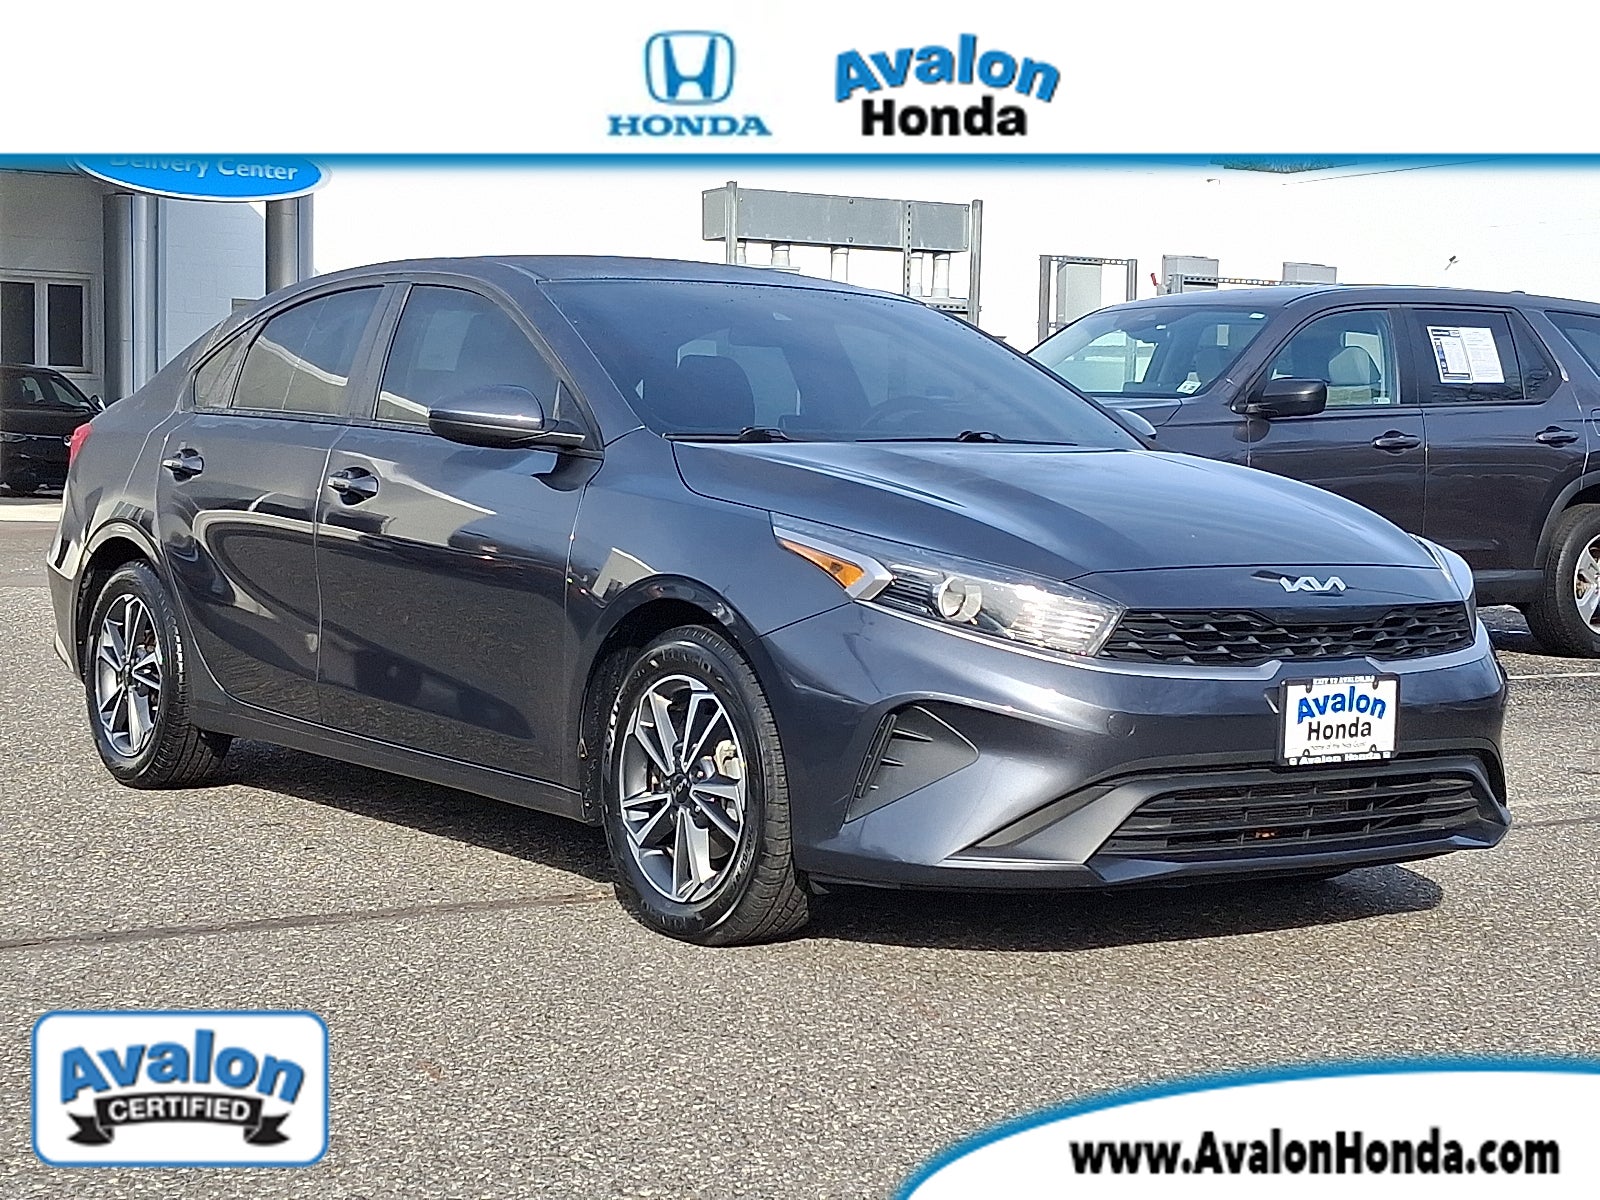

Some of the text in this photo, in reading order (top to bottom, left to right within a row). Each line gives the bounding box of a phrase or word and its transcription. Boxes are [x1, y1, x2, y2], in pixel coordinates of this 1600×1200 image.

[216, 157, 299, 181] Center
[1297, 686, 1387, 724] Avalon
[1307, 717, 1372, 741] Honda
[1298, 752, 1381, 766] Avalon Honda
